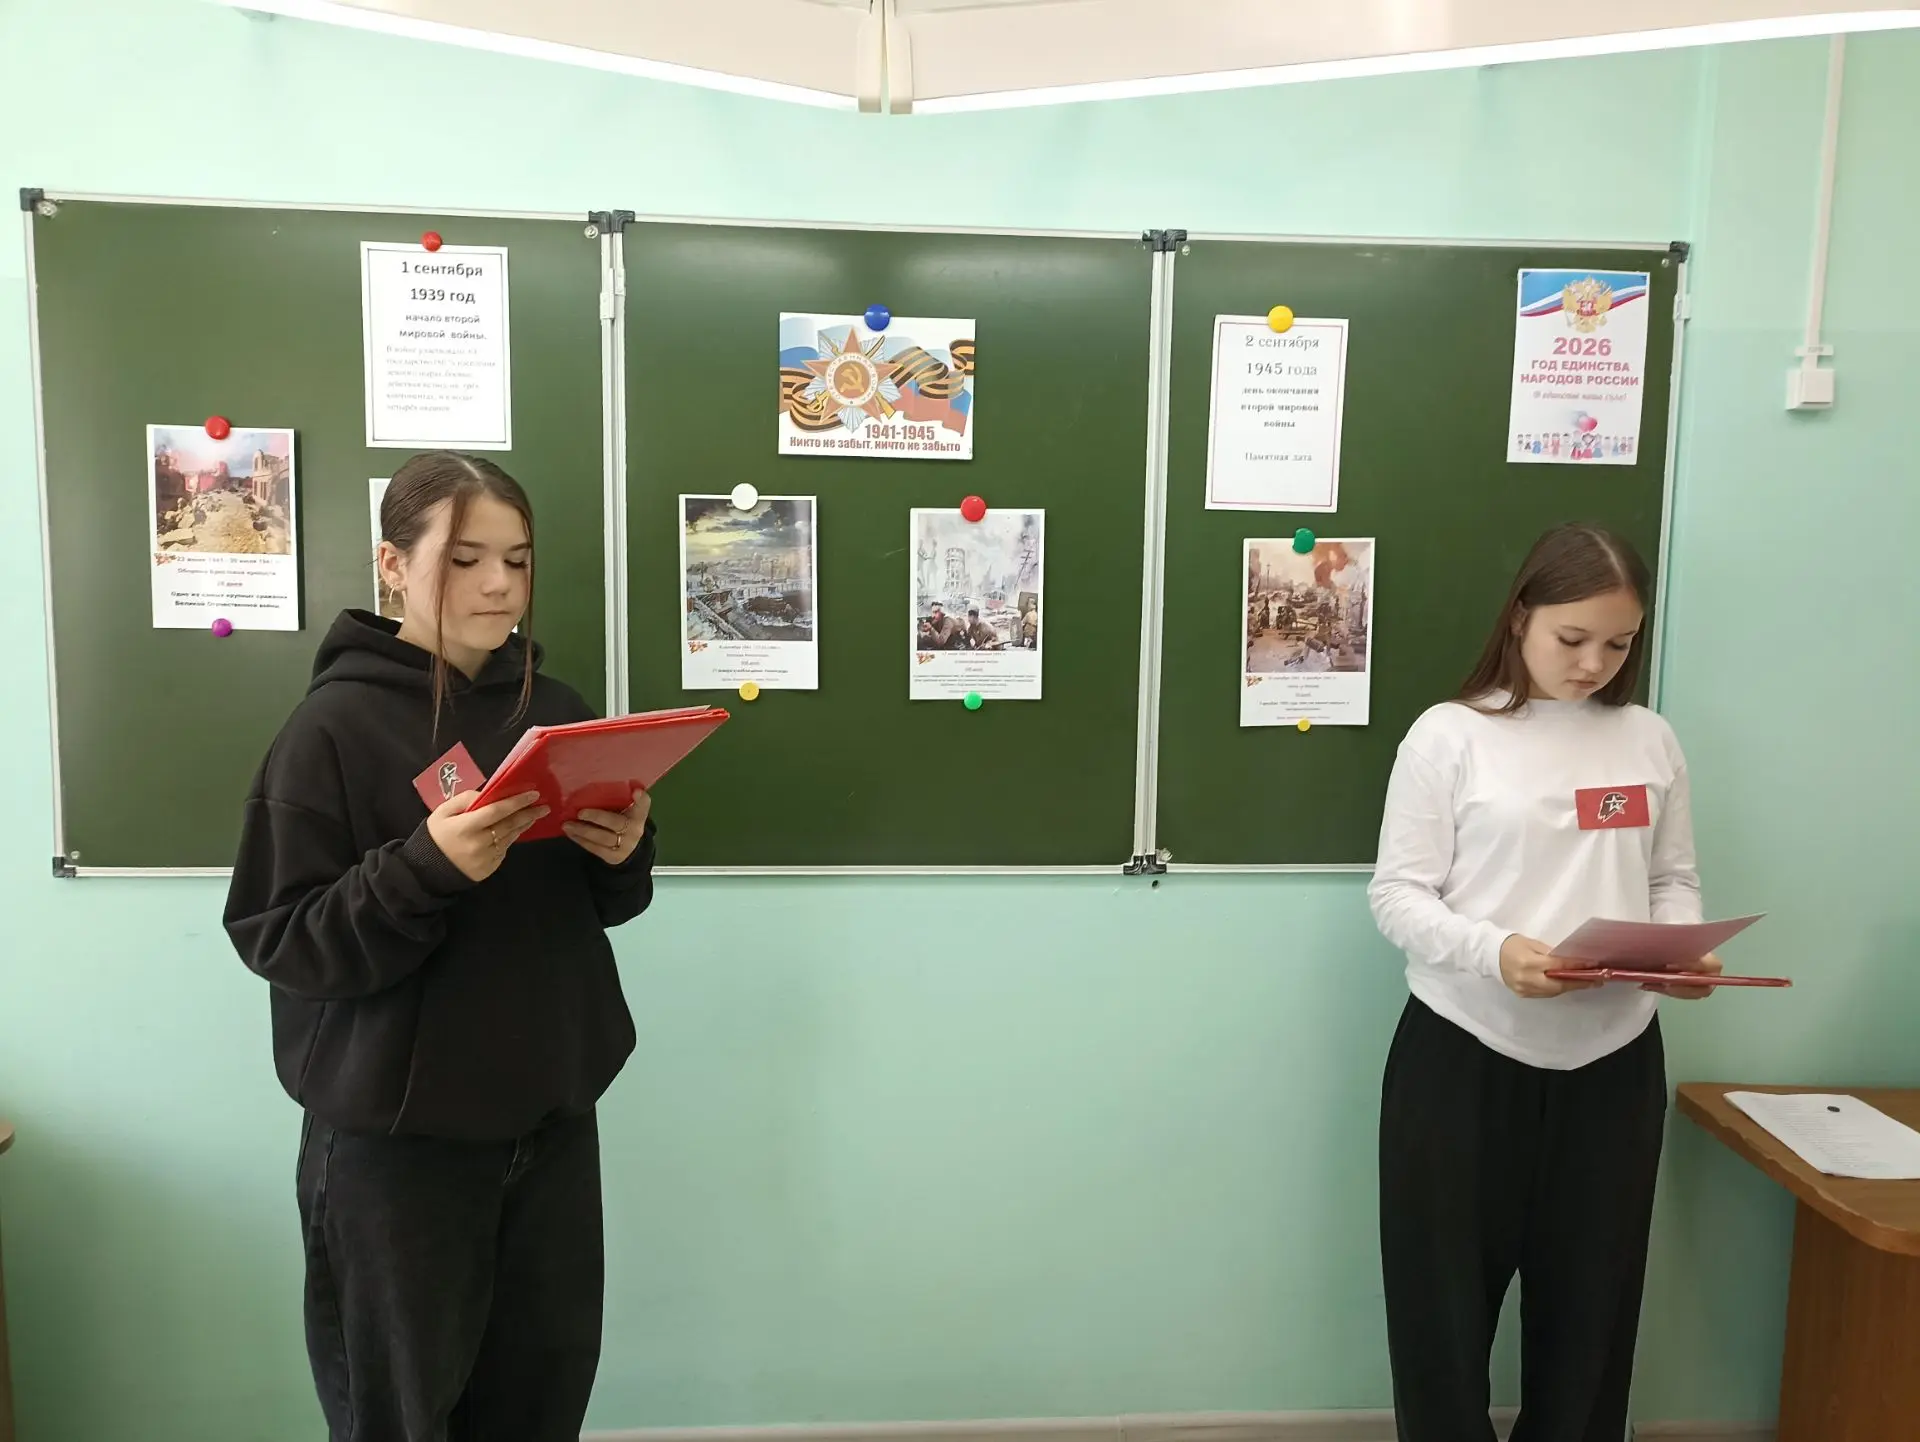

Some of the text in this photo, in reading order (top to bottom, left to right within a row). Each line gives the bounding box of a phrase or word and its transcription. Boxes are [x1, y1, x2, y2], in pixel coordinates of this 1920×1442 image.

[402, 261, 483, 278] 1 сентября
[410, 288, 476, 305] 1939 год
[405, 314, 481, 325] начало второй
[399, 329, 446, 340] мировой
[1245, 334, 1319, 351] 2 сентября
[1552, 337, 1612, 356] 2026
[1247, 362, 1318, 377] 1945 года
[1531, 359, 1631, 373] ГОД ЕДИНСТВА
[1520, 373, 1640, 387] НАРОДОВ РОССИИ
[1242, 387, 1320, 396] день окончания
[1240, 403, 1320, 414] второй мировой
[1263, 419, 1297, 429] войны
[865, 424, 936, 441] 1941-1945
[789, 437, 821, 449] Никто
[823, 439, 836, 449] не
[874, 440, 906, 452] ничто
[907, 442, 920, 452] не
[921, 441, 962, 453] забыто
[1244, 452, 1314, 463] Памятная дата
